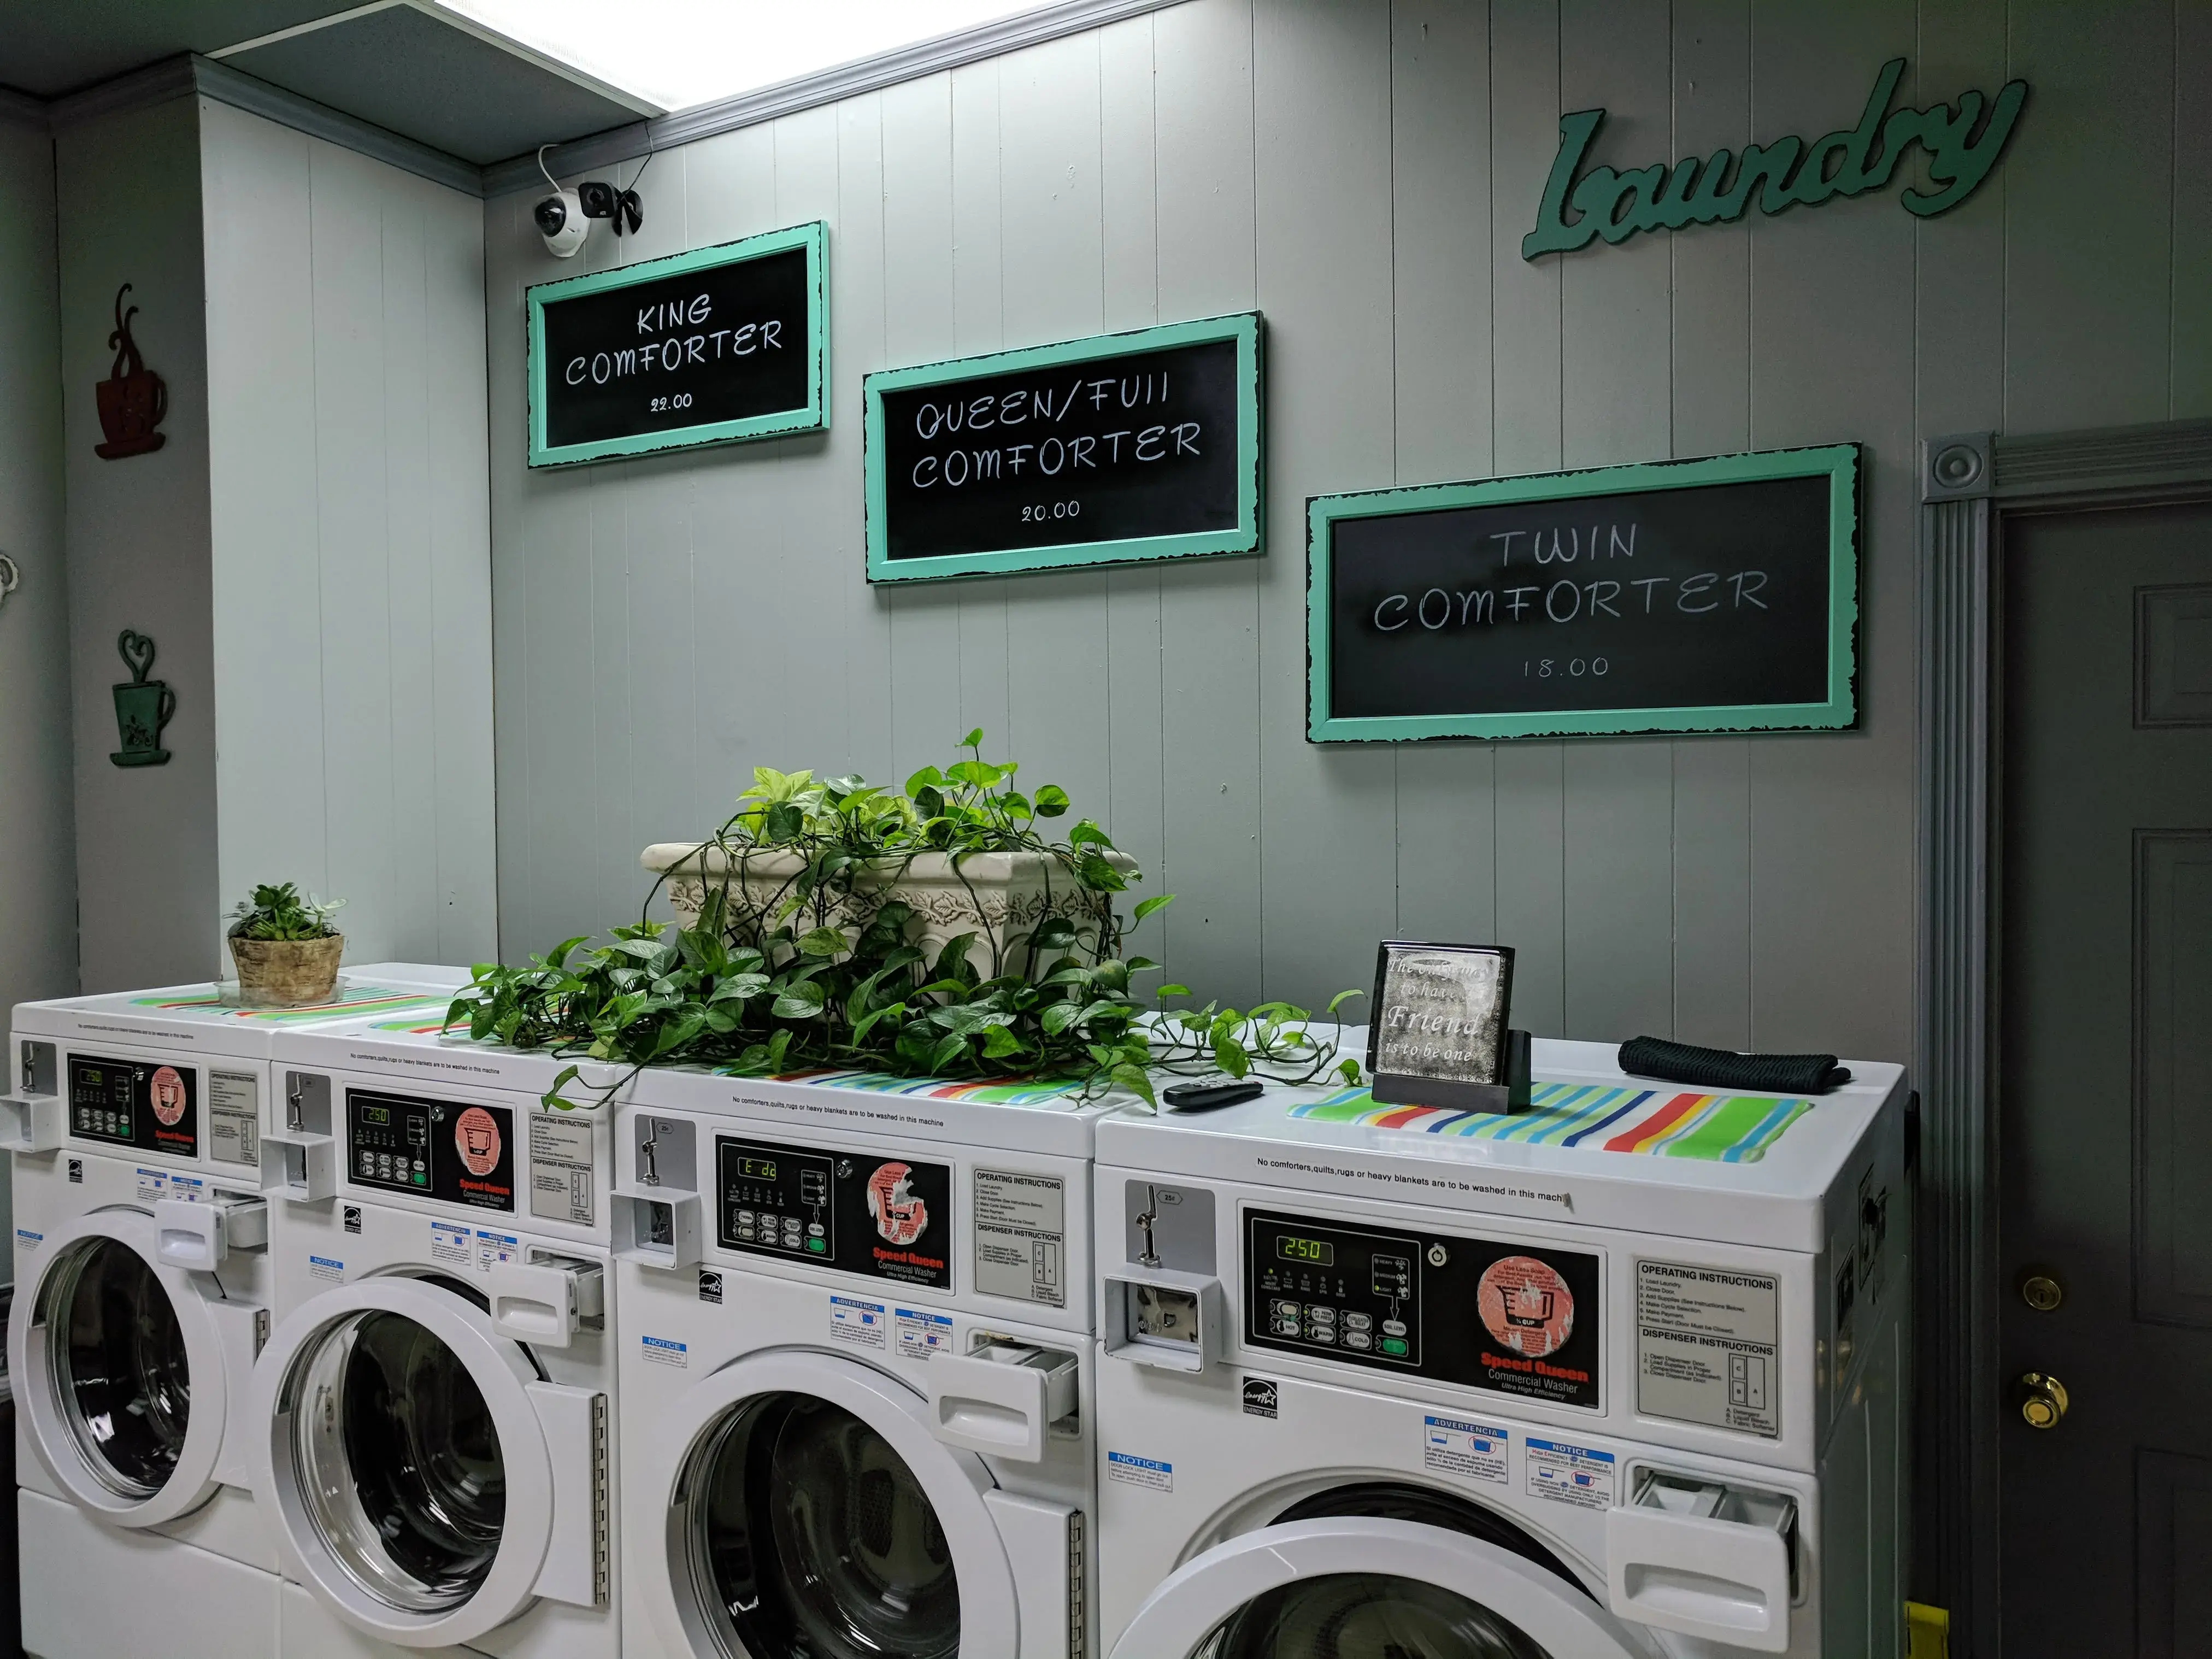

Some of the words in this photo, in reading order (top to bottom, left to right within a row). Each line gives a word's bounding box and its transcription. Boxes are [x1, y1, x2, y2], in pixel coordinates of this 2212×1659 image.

[1522, 57, 2028, 261] Laundry
[637, 293, 711, 334] KING
[566, 320, 782, 385] COMFORTER
[651, 392, 692, 413] 22.00
[913, 422, 1201, 488] COMFORTER
[1022, 500, 1080, 522] 20.00
[1490, 523, 1637, 567] TWIN
[1374, 570, 1768, 631] COMFORTER
[1524, 656, 1609, 678] 18.00
[1389, 958, 1413, 973] The
[1387, 1005, 1481, 1036] Friend
[1386, 1039, 1398, 1052] is
[1402, 1043, 1418, 1056] to
[1423, 1042, 1439, 1058] be
[1444, 1050, 1472, 1062] one
[532, 1116, 556, 1124] OPERATING
[558, 1119, 590, 1128] INSTRUCTIONS
[825, 1107, 847, 1115] blankets
[919, 1117, 943, 1127] machine
[558, 1162, 591, 1172] INSTRUCTIONS
[745, 1160, 752, 1173] E
[460, 1179, 484, 1189] Speed
[485, 1182, 509, 1195] Queen
[977, 1173, 1012, 1183] OPERATING
[1014, 1178, 1061, 1189] INSTRUCTIONS
[1257, 1157, 1268, 1166] No
[1368, 1171, 1391, 1182] heavy
[1395, 1174, 1429, 1186] blankets
[1459, 1182, 1469, 1190] be
[1472, 1185, 1505, 1195] washed
[1519, 1190, 1534, 1199] this
[1538, 1192, 1563, 1202] mach
[463, 1190, 488, 1201] Commercial
[489, 1194, 505, 1203] Washer
[978, 1224, 1012, 1234] DISPENSER
[1014, 1229, 1061, 1242] INSTRUCTIONS
[873, 1247, 907, 1262] Speed
[909, 1252, 944, 1269] Queen
[1285, 1238, 1320, 1258] 250
[878, 1260, 913, 1274] Commercial
[914, 1267, 937, 1278] Washer
[1642, 1264, 1697, 1279] OPERATING
[1699, 1273, 1773, 1290] INSTRUCTIONS
[837, 1298, 878, 1310] ADVERTENCIA
[1657, 1295, 1680, 1304] Supplies
[1695, 1301, 1725, 1309] Instructions
[913, 1313, 936, 1321] NOTICE
[649, 1338, 680, 1350] NOTICE
[1643, 1328, 1697, 1344] DISPENSER
[1699, 1337, 1773, 1355] INSTRUCTIONS
[1481, 1352, 1532, 1372] Speed
[1535, 1361, 1589, 1382] Queen
[1489, 1369, 1540, 1387] Commercial
[1543, 1378, 1578, 1394] Washer
[1517, 1385, 1532, 1393] High
[1534, 1388, 1566, 1400] Efficiency
[1244, 1407, 1263, 1415] ENERGY
[1434, 1419, 1498, 1436] ADVERTENCIA
[1552, 1444, 1588, 1457] NOTICE
[1117, 1454, 1163, 1470] NOTICE
